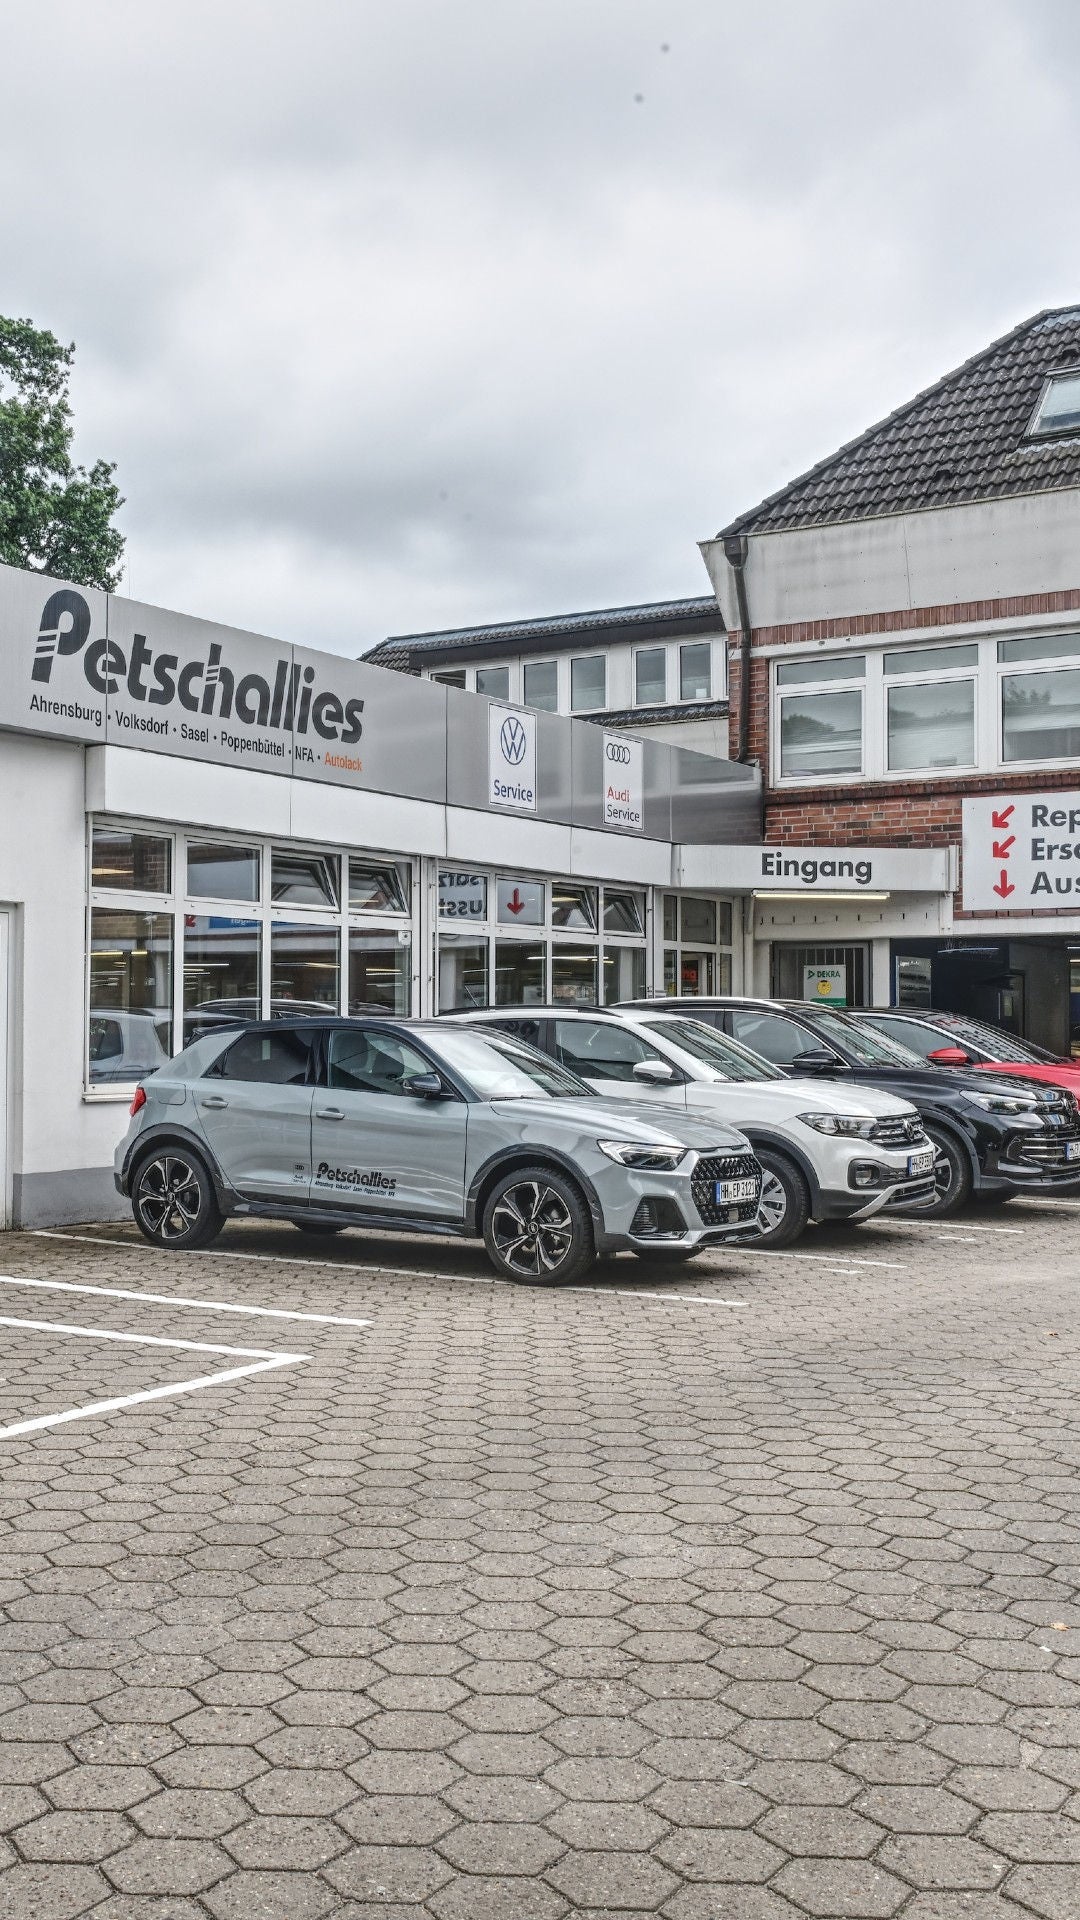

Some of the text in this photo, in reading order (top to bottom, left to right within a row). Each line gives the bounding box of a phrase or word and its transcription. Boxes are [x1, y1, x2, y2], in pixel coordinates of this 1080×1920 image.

[31, 589, 365, 744] Petschallies
[30, 694, 363, 771] Ahrensburg Volksdorf Sasel Poppenbüttel NFA Autolack
[494, 779, 533, 802] Service
[607, 786, 630, 803] Audi
[607, 804, 640, 823] Service
[761, 852, 872, 885] Eingang
[816, 970, 841, 979] DEKRA
[316, 1161, 397, 1190] Petschallies
